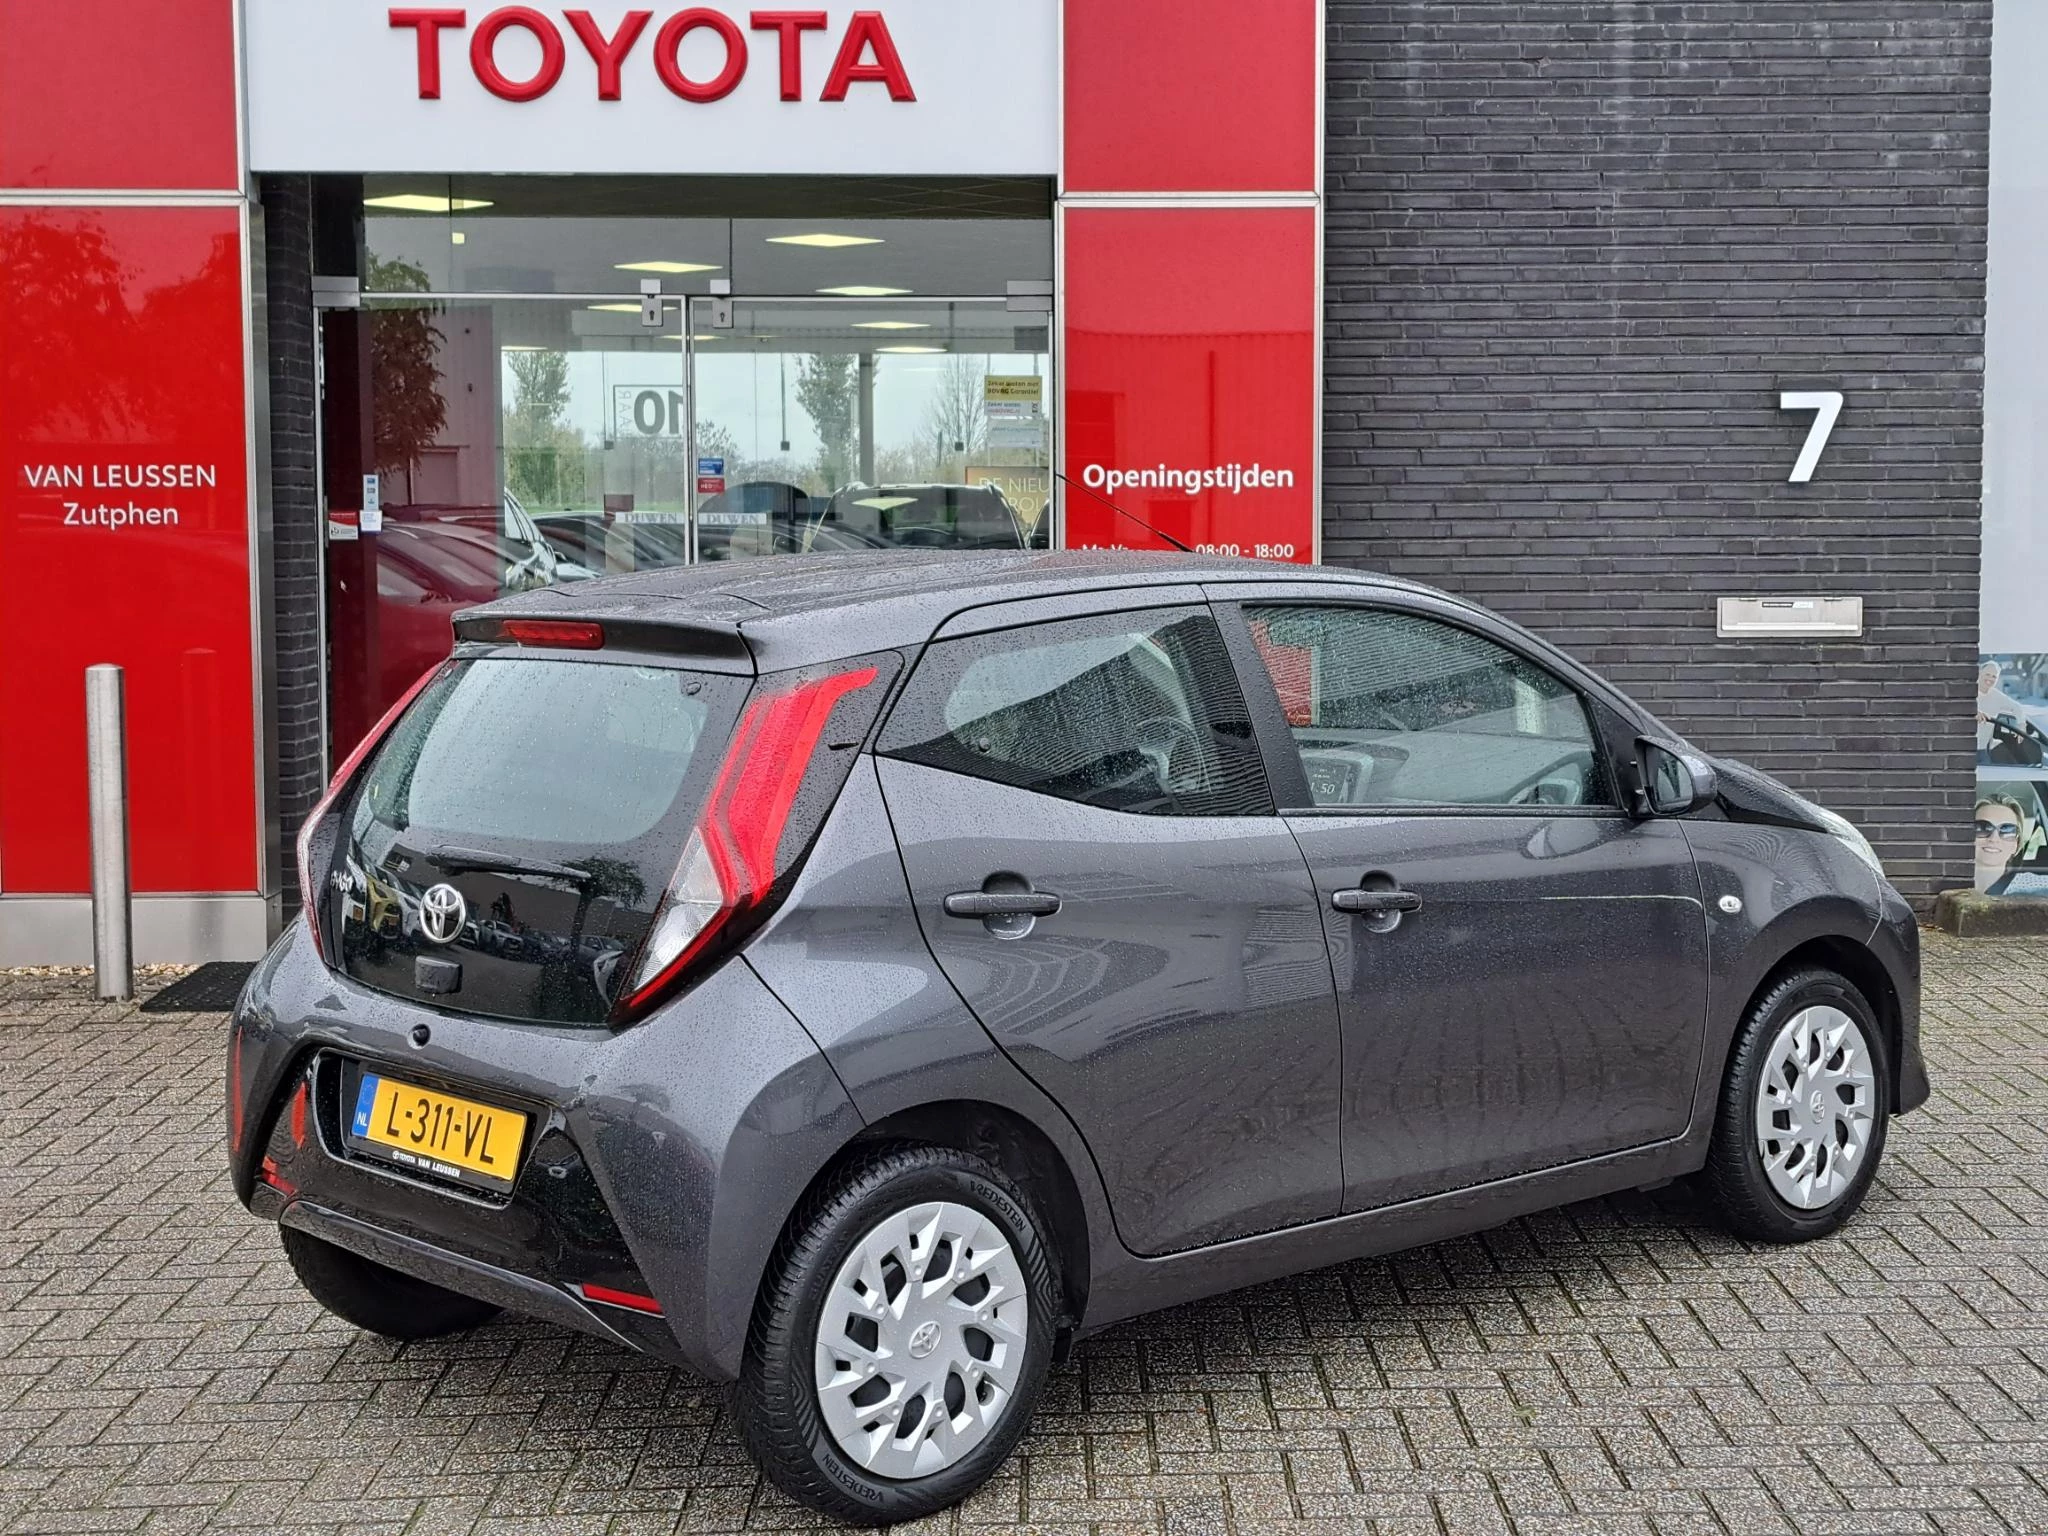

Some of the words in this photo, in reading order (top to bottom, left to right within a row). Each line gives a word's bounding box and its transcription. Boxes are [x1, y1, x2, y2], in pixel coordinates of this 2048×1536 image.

[388, 6, 917, 103] TOYOTA
[1780, 391, 1844, 482] 7
[24, 464, 83, 488] VAN
[92, 464, 217, 488] LEUSSEN
[1082, 463, 1294, 494] Openingstijden
[63, 501, 180, 531] Zutphen
[625, 513, 677, 524] DUWEN
[707, 513, 759, 525] DUWEN
[1196, 543, 1240, 557] 08:00
[1254, 543, 1294, 558] 18:00
[356, 1111, 368, 1127] NL
[386, 1091, 494, 1165] L-311-VL
[418, 1157, 431, 1169] VAN
[432, 1161, 460, 1178] LEUSSEN
[822, 1453, 884, 1502] VREDESTEIN
